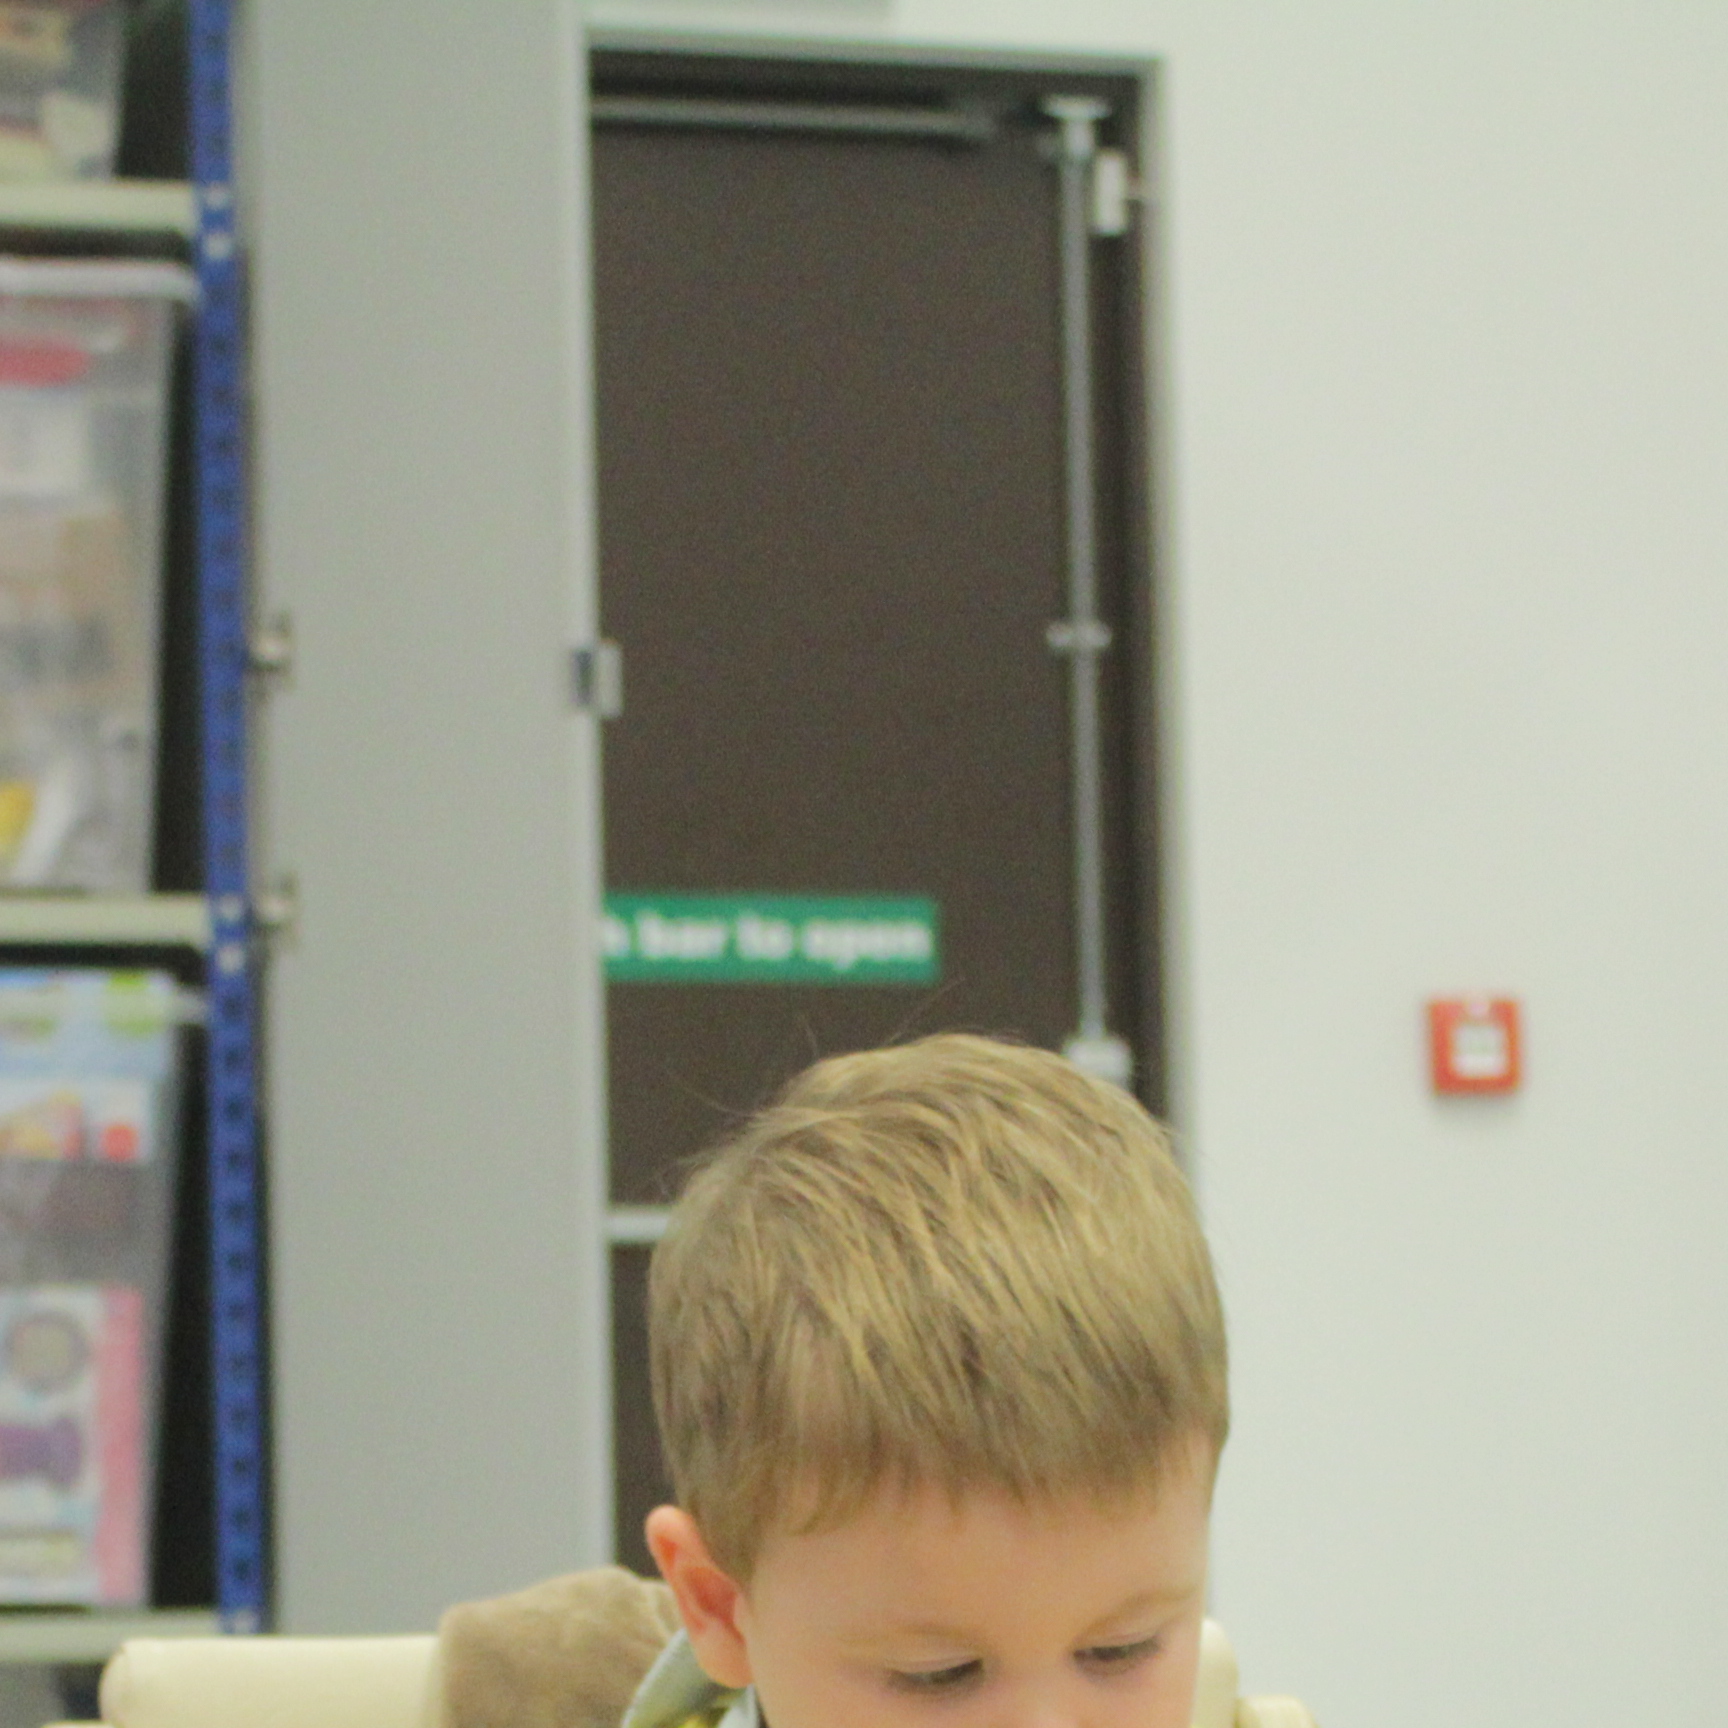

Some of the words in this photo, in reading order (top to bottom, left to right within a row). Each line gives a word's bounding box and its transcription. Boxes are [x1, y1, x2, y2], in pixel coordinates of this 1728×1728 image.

[636, 911, 726, 958] bar
[736, 910, 791, 959] to
[803, 917, 931, 971] open
